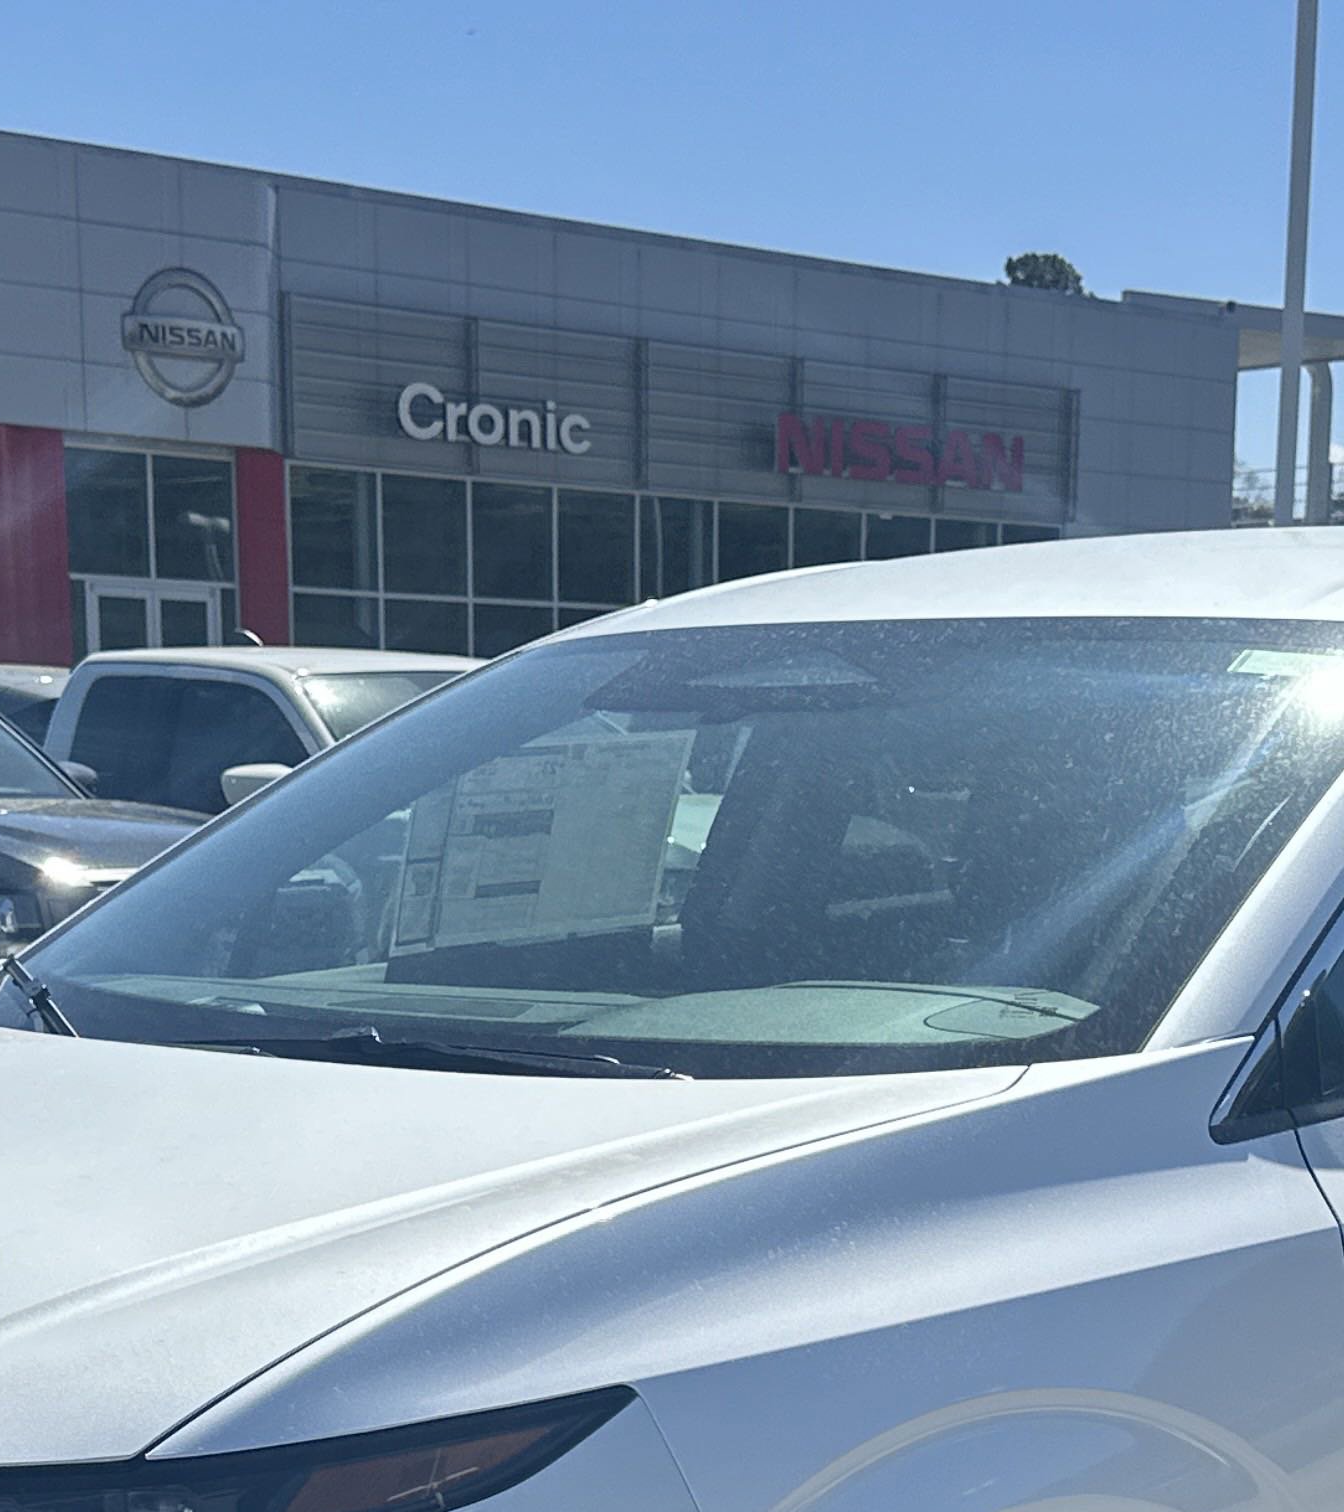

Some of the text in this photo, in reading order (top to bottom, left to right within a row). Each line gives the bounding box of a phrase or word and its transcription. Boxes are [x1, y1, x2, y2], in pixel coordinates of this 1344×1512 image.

[138, 322, 237, 353] NISSAN
[398, 382, 592, 454] Cronic
[776, 411, 1025, 493] NISSAN
